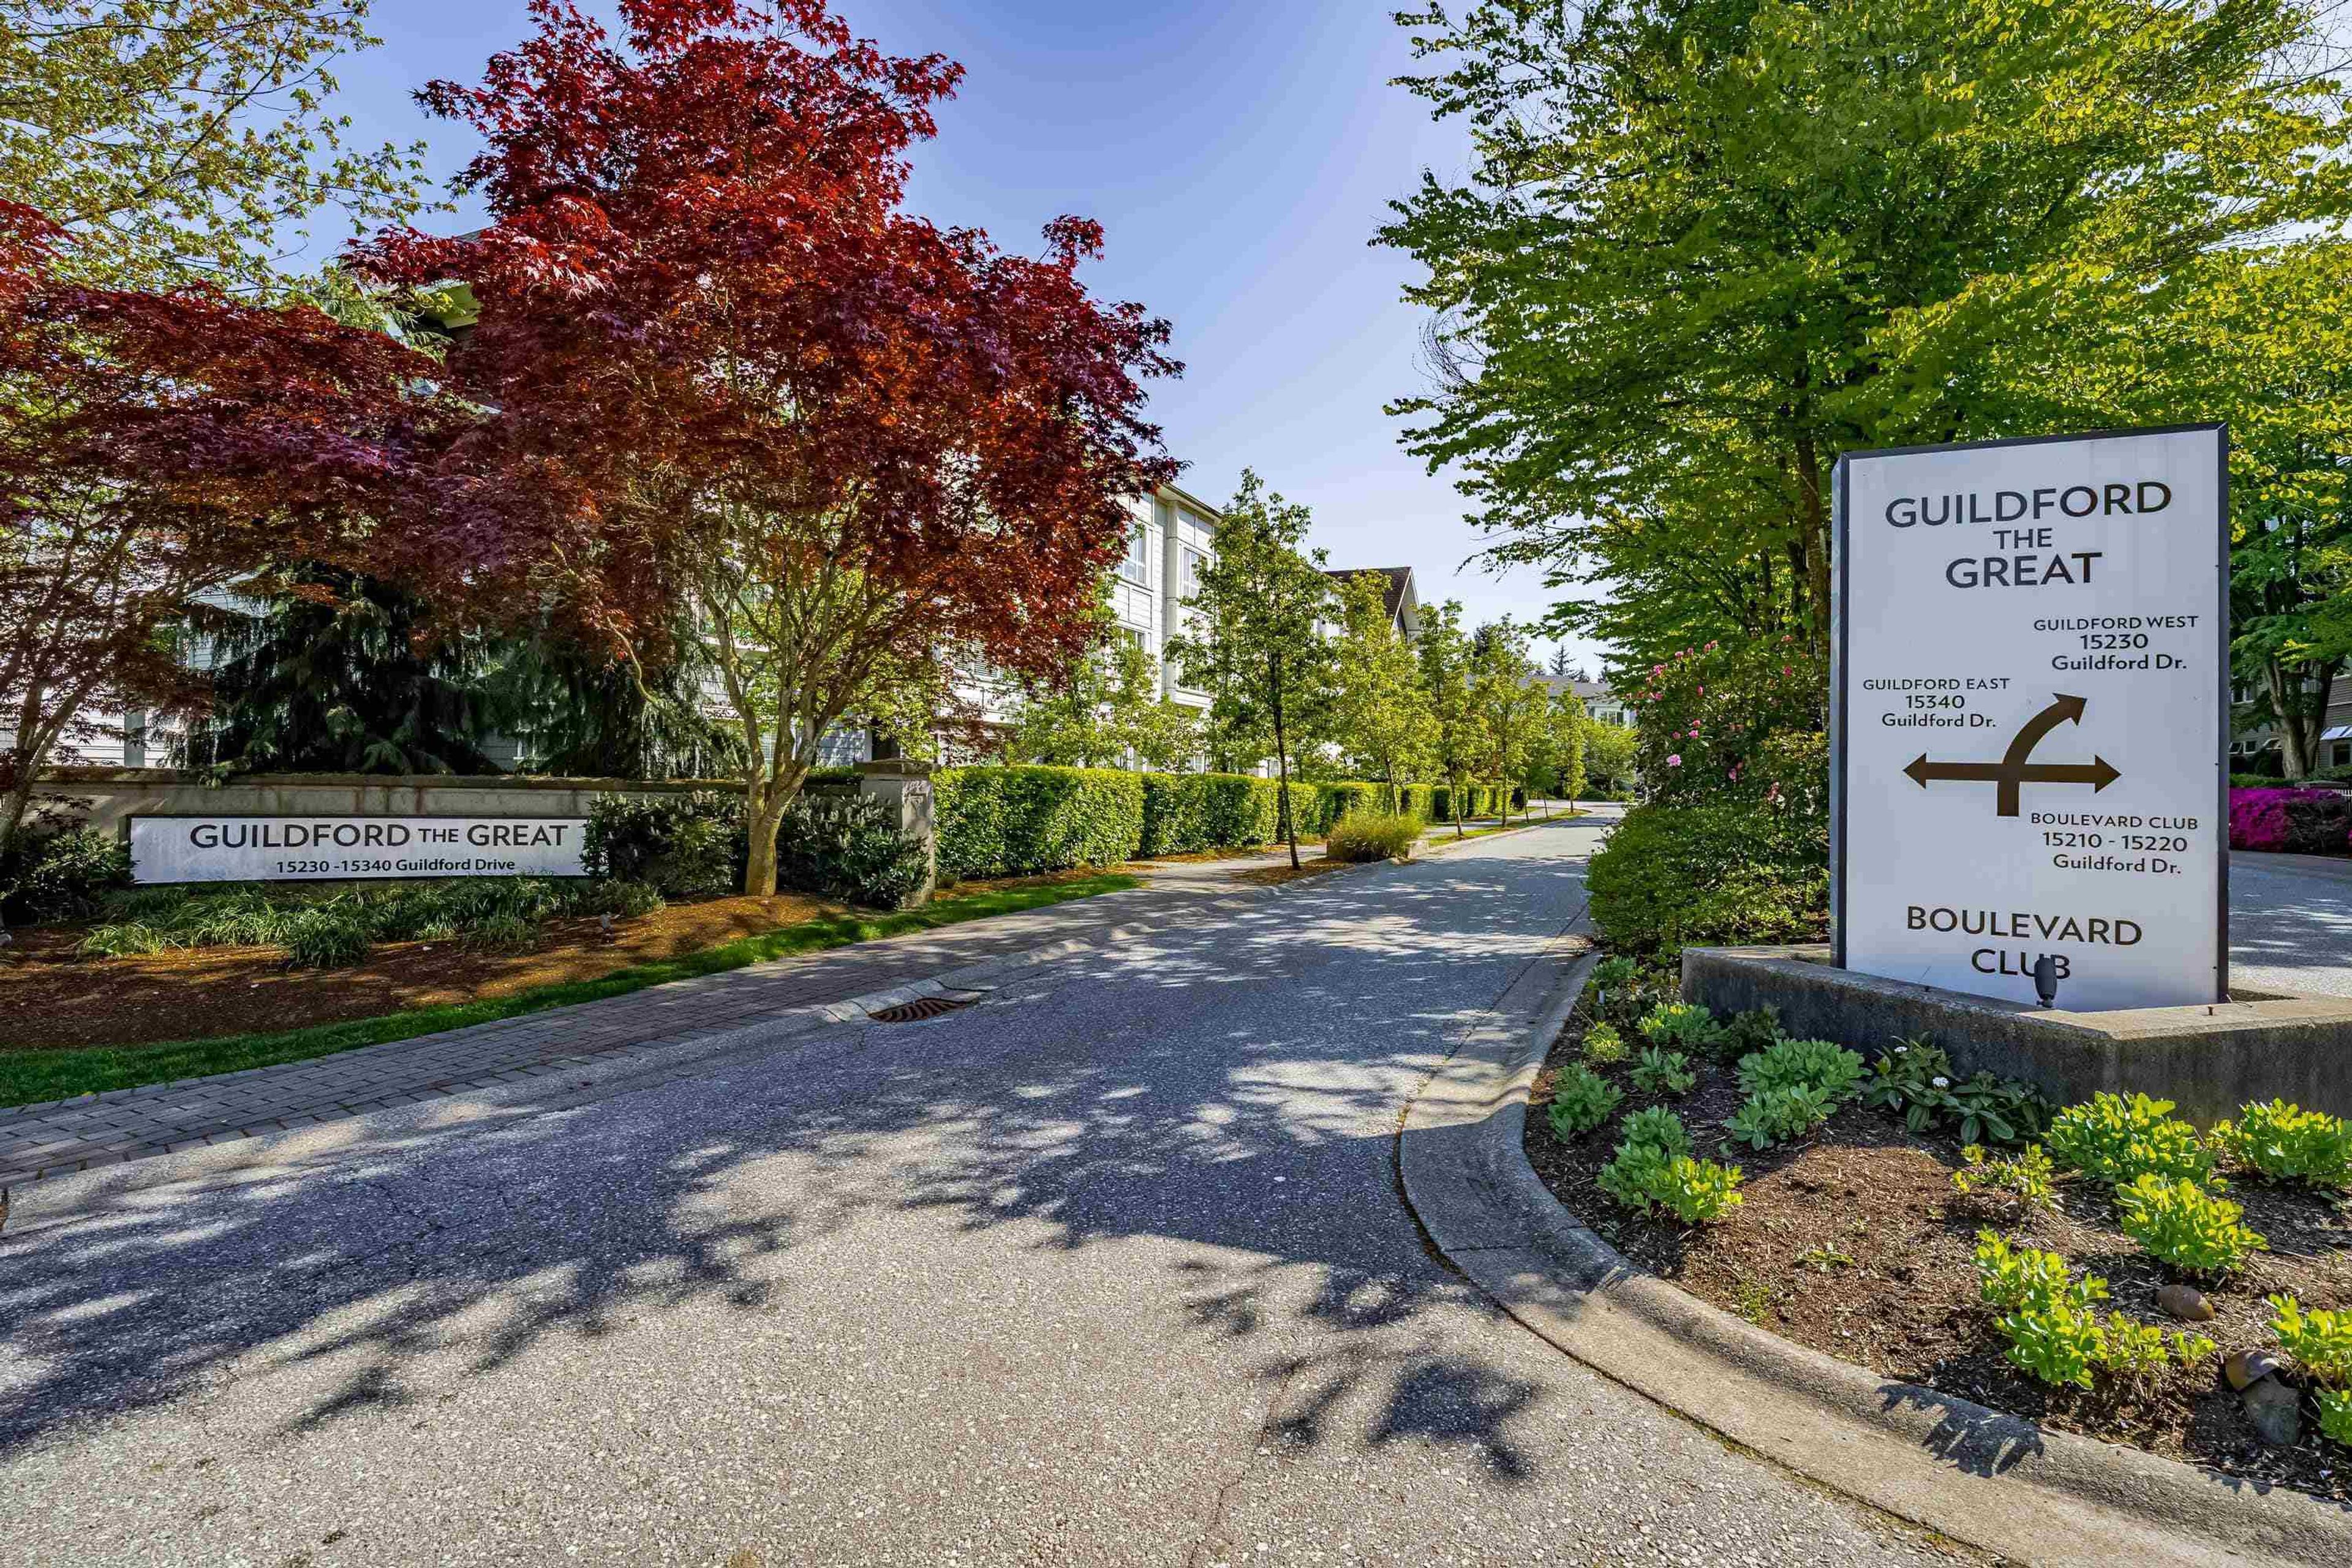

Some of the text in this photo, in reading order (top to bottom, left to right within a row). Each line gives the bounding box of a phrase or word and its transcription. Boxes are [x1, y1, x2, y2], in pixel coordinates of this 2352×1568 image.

[1885, 481, 2172, 528] GUILDFORD
[1992, 527, 2052, 550] THE
[1945, 551, 2103, 589] GREAT
[2034, 616, 2199, 631] GUILDFORD WEST
[2079, 633, 2149, 650] 15230
[2051, 654, 2187, 671] Guildford Dr.
[1863, 677, 2011, 690] GUILDFORD EAST
[1905, 695, 1965, 709] 15340
[1882, 712, 1996, 728] Guildford Dr.
[2031, 812, 2198, 830] BOULEVARD CLUB
[190, 824, 568, 849] GUILDFORD THE GREAT
[2042, 832, 2102, 848] 15210
[2121, 835, 2188, 852] 15220
[276, 861, 330, 873] 15230
[395, 858, 471, 872] Guildford
[475, 859, 515, 870] Drive
[2053, 854, 2181, 874] Guildford Dr.
[1907, 906, 2143, 946] BOULEVARD
[1971, 948, 2071, 980] CLUB
